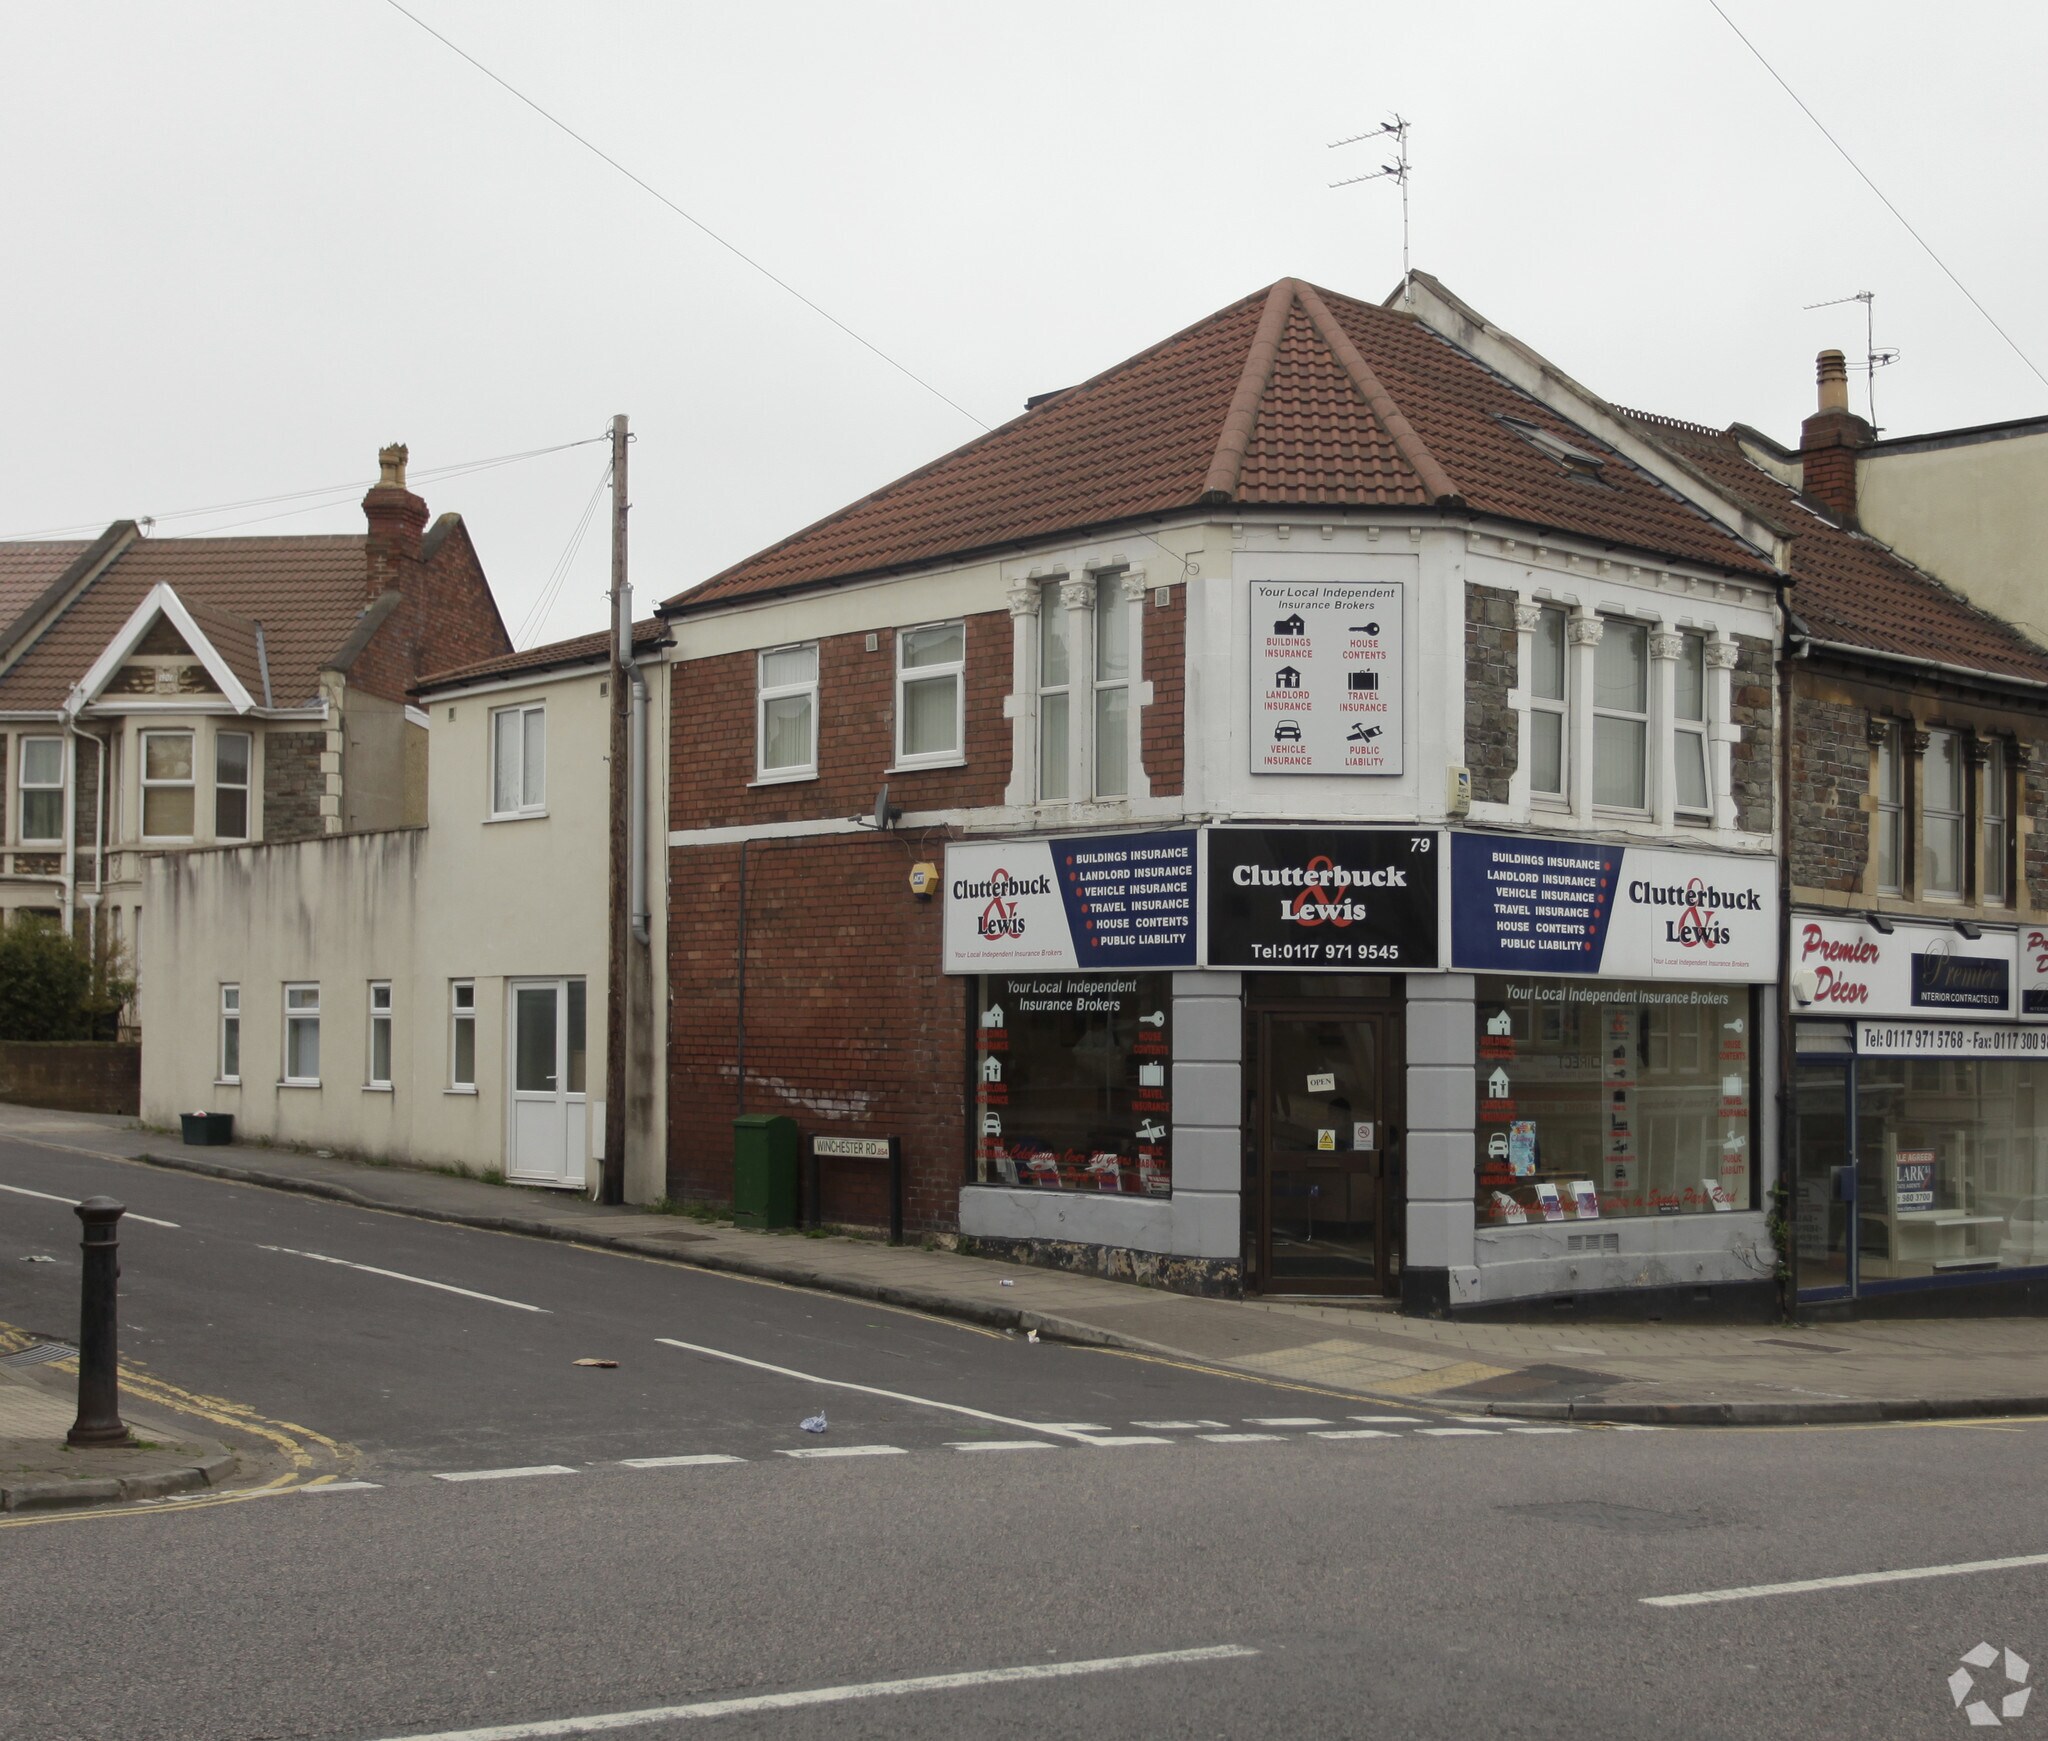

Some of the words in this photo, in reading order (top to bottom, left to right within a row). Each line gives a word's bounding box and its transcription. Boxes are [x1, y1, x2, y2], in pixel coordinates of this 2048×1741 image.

[1260, 588, 1285, 597] Your
[1287, 588, 1318, 597] Local
[1323, 588, 1395, 599] Independent
[1278, 600, 1330, 609] Insurance
[1334, 601, 1374, 610] Brokers
[1266, 638, 1311, 647] BUILDINGS
[1350, 640, 1378, 648] HOUSE
[1265, 650, 1312, 658] INSURANCE
[1342, 651, 1386, 660] CONTENTS
[1266, 690, 1310, 699] LANDLORD
[1348, 692, 1378, 700] TRAVEL
[1264, 702, 1312, 711] INSURANCE
[1340, 704, 1388, 712] INSURANCE
[1270, 745, 1306, 754] VEHICLE
[1350, 746, 1380, 755] PUBLIC
[1264, 756, 1312, 766] INSURANCE
[1345, 758, 1384, 766] LIABILITY
[1410, 838, 1430, 853] 79
[1076, 852, 1128, 864] BUILDINGS
[1130, 848, 1188, 861] INSURANCE
[1492, 852, 1544, 866] BUILDINGS
[1547, 857, 1600, 870] INSURANCE
[1080, 869, 1130, 882] LANDLORD
[1134, 866, 1192, 878] INSURANCE
[1232, 864, 1407, 886] Clutterbuck
[1488, 870, 1538, 882] LANDLORD
[1542, 874, 1596, 887] INSURANCE
[953, 874, 1051, 900] Clutterbuck
[1084, 886, 1125, 896] VEHICLE
[1130, 882, 1188, 894] INSURANCE
[1496, 887, 1536, 899] VEHICLE
[1541, 890, 1594, 902] INSURANCE
[1628, 880, 1761, 910] Clutterbuck
[1090, 902, 1126, 913] TRAVEL
[1131, 898, 1189, 911] INSURANCE
[1281, 898, 1366, 920] Lewis
[1494, 904, 1530, 915] TRAVEL
[1536, 906, 1589, 918] INSURANCE
[978, 911, 1026, 935] Lewis
[1096, 918, 1130, 929] HOUSE
[1136, 916, 1188, 928] CONTENTS
[1496, 921, 1530, 932] HOUSE
[1536, 923, 1585, 934] CONTENTS
[1666, 920, 1730, 944] Lewis
[1100, 935, 1136, 946] PUBLIC
[1138, 934, 1186, 944] LIABILITY
[1501, 938, 1536, 949] PUBLIC
[1538, 940, 1582, 950] LIABILITY
[1802, 924, 1880, 964] Premier
[982, 950, 1014, 958] Independent
[1014, 950, 1040, 958] Insurance
[1041, 948, 1062, 956] Brokers
[1326, 944, 1352, 958] 971
[1358, 945, 1398, 959] 9545
[1679, 958, 1708, 968] Independent
[1708, 960, 1730, 968] Insurance
[1008, 980, 1031, 994] Your
[1032, 980, 1062, 994] Local
[1066, 978, 1137, 996] Independent
[1814, 966, 1869, 1004] Décor
[1506, 984, 1533, 1000] Your
[1534, 986, 1566, 1000] Local
[1568, 988, 1637, 1005] Independent
[1638, 990, 1688, 1004] Insurance
[1690, 991, 1728, 1005] Brokers
[1920, 992, 1950, 1002] INTERIOR
[1950, 992, 1988, 1003] CONTRACTS
[1988, 994, 2000, 1004] LTD
[1020, 998, 1073, 1010] Insurance
[1076, 997, 1120, 1010] Brokers
[1865, 1028, 1883, 1048] Tel:
[1886, 1029, 1913, 1048] 0117
[1915, 1030, 1936, 1048] 971
[1936, 1030, 1964, 1048] 5768
[1973, 1031, 1992, 1050] Fax:
[1994, 1032, 2018, 1050] 0117
[2020, 1032, 2038, 1050] 300
[2040, 1032, 2048, 1050] 9
[1310, 1078, 1332, 1086] OPEN
[816, 1140, 864, 1154] WINCHESTER
[866, 1142, 877, 1154] RD
[1908, 1152, 1932, 1162] AGREED
[1896, 1166, 1924, 1182] LARK
[1712, 1186, 1738, 1204] Road
